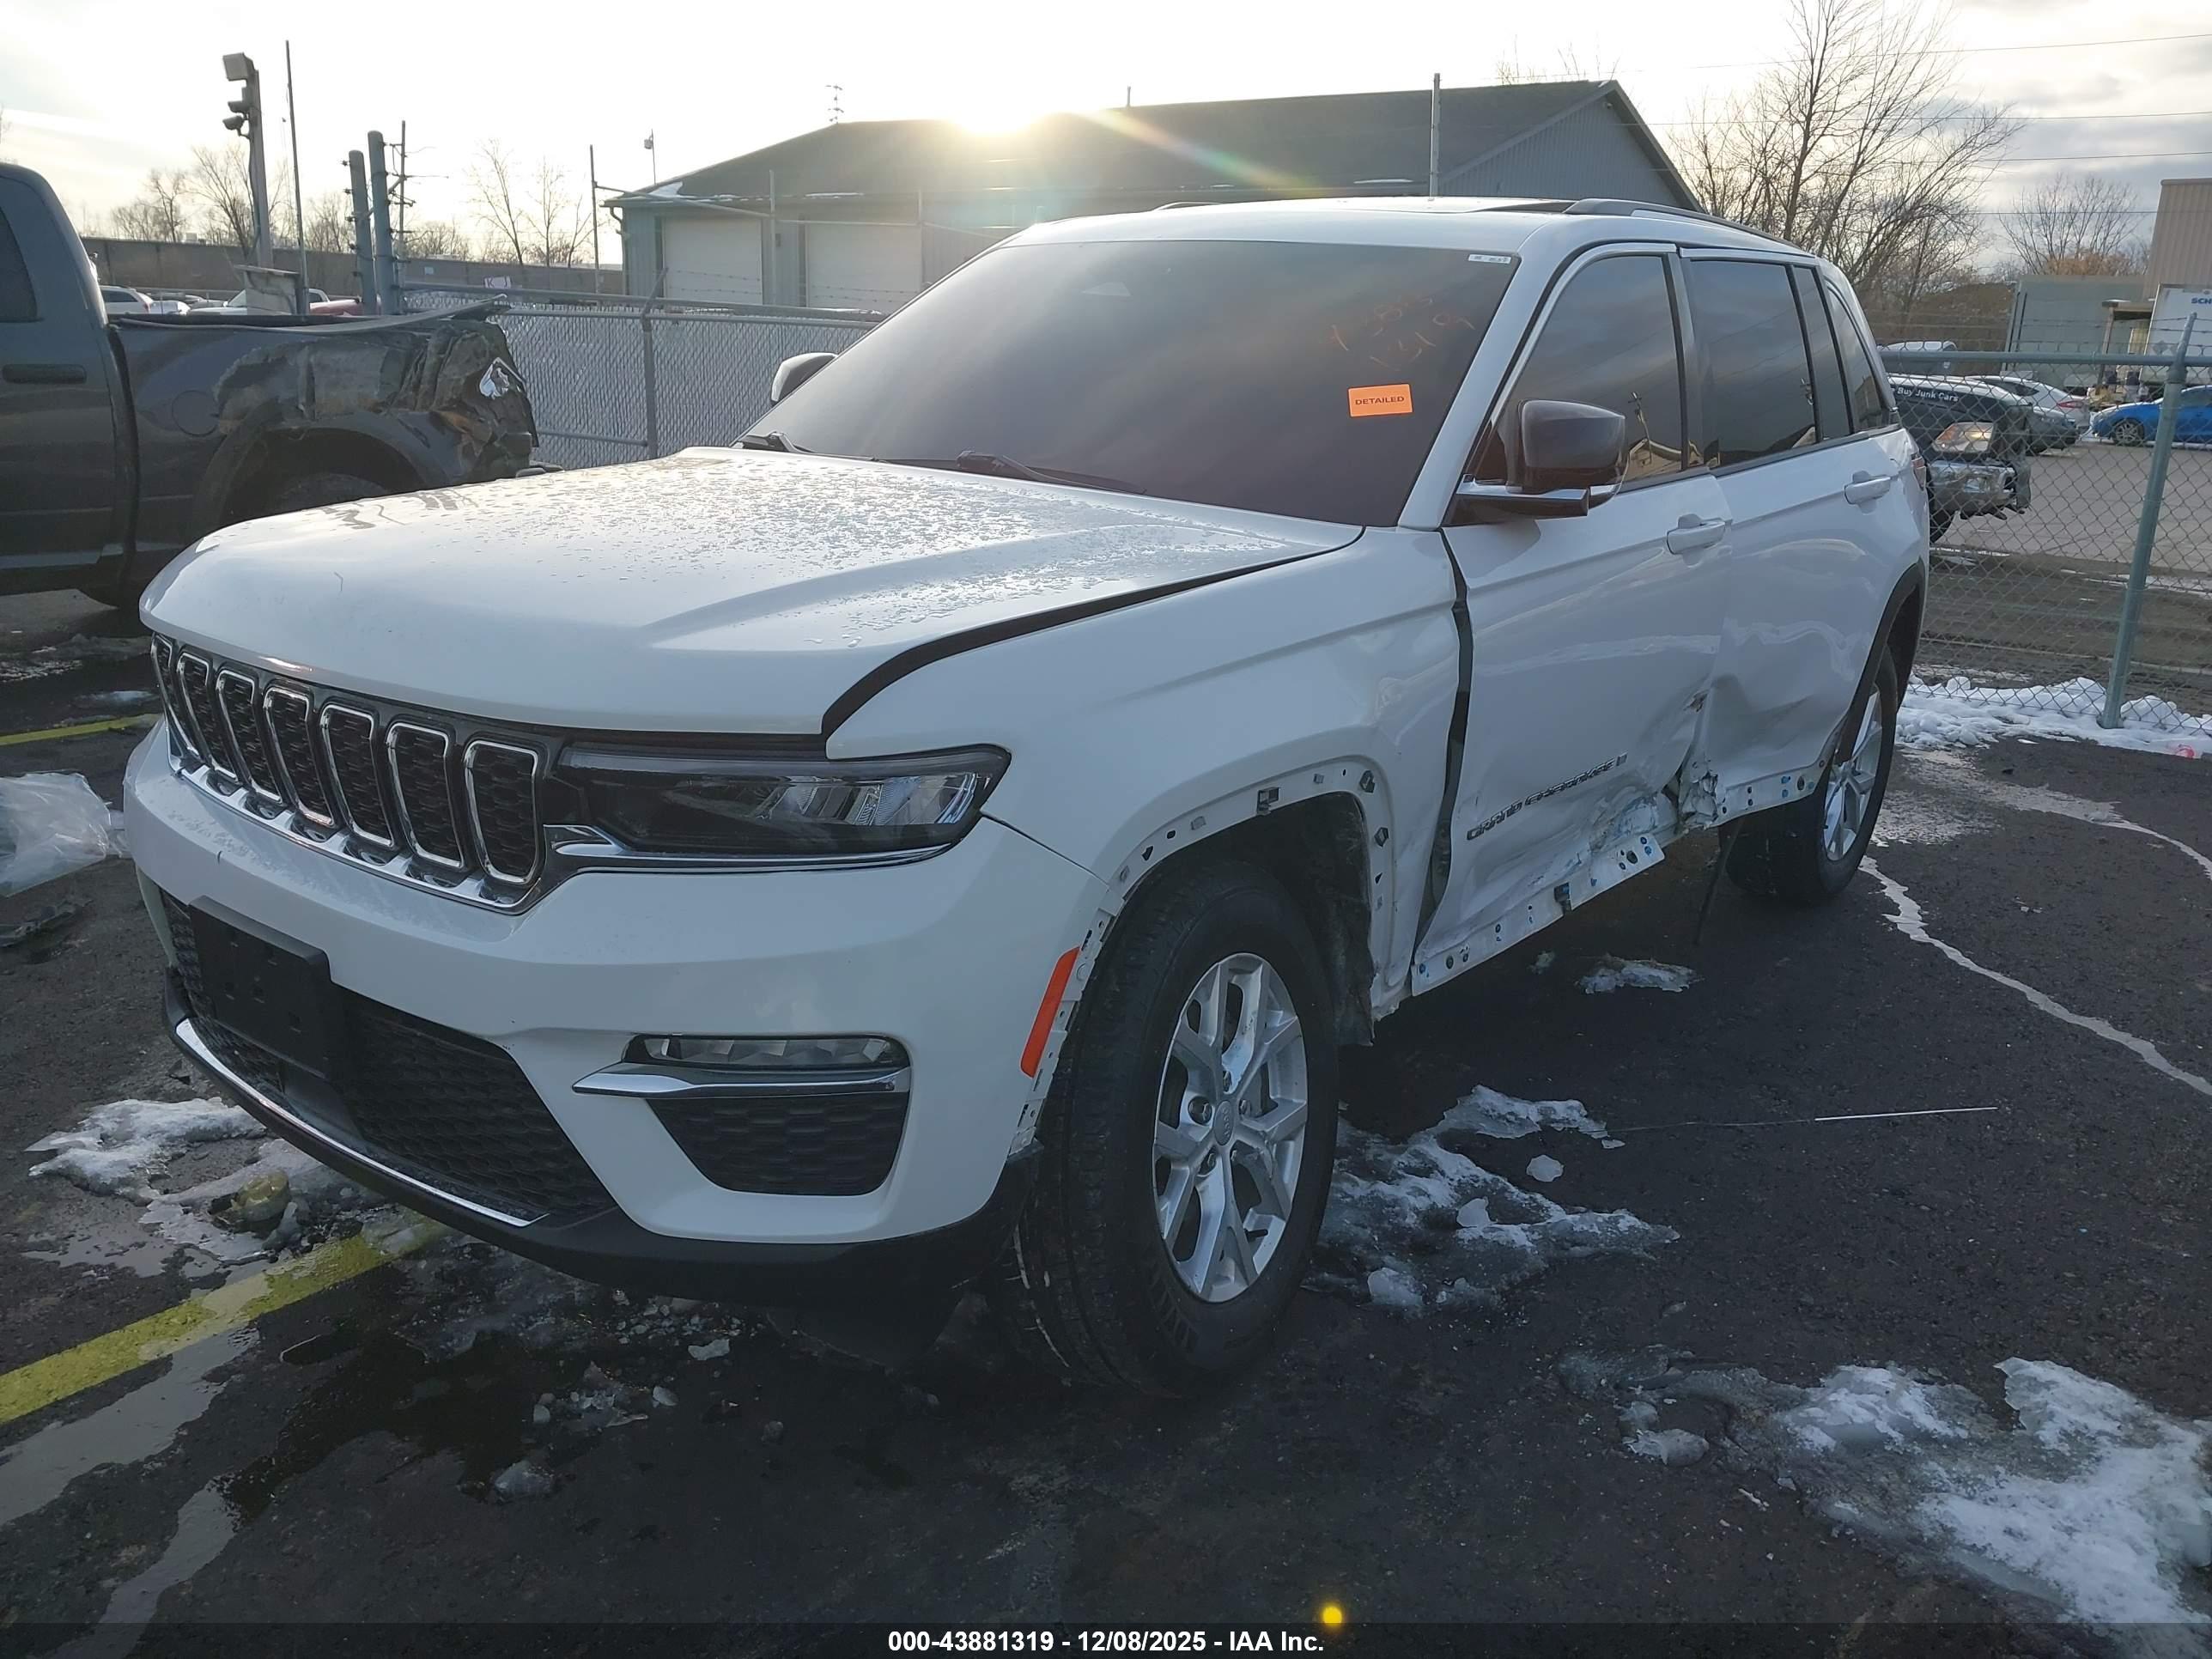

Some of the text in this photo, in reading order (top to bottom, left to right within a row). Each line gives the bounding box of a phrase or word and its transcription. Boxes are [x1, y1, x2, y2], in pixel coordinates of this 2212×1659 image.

[1355, 396, 1405, 405] DETAILED
[1898, 386, 1913, 397] Buy
[1915, 389, 1936, 398] Junk
[1938, 392, 1959, 402] Cars
[1467, 757, 1615, 841] GRAND CHEROKEE
